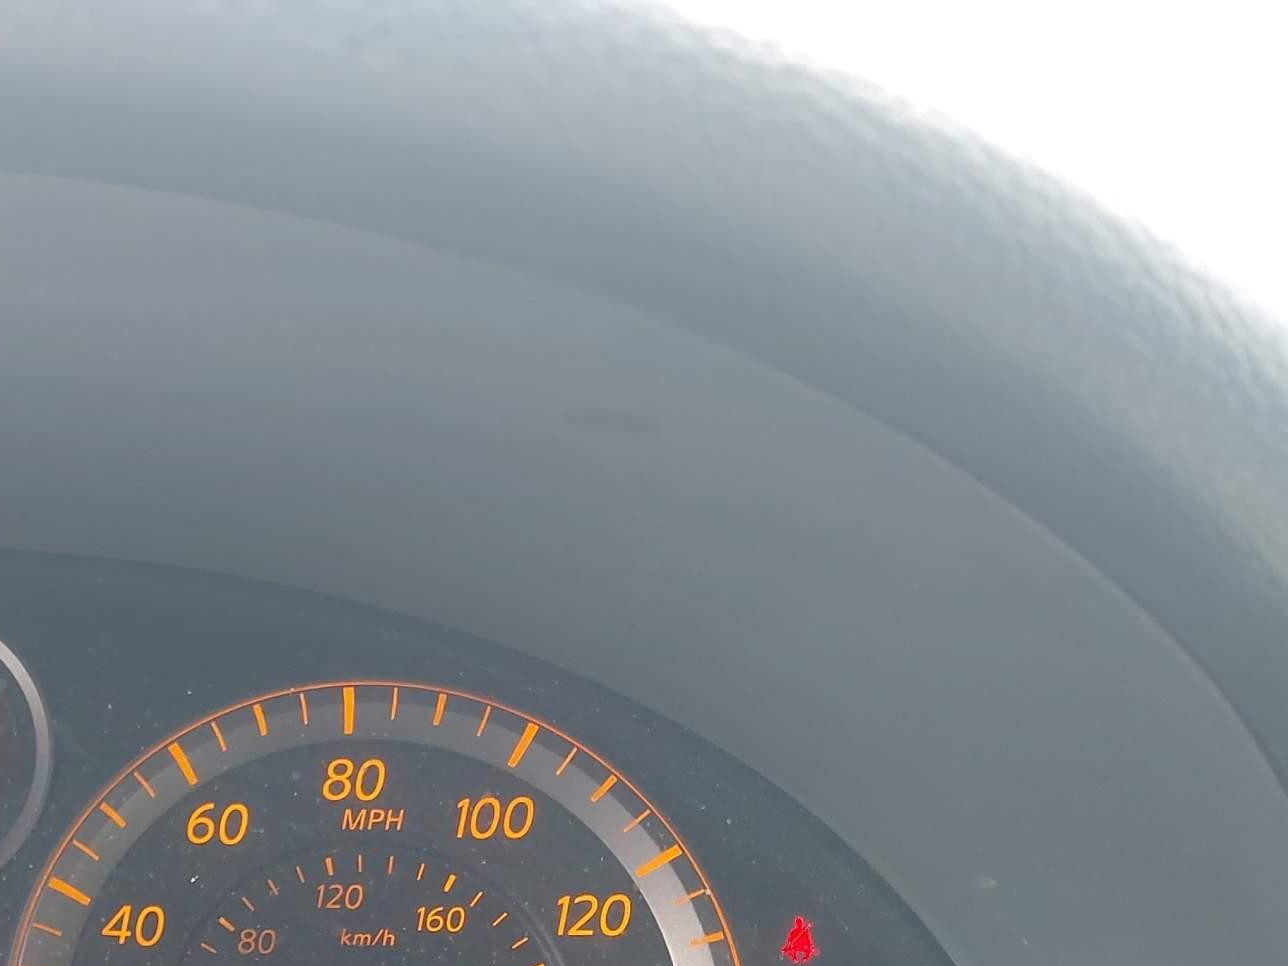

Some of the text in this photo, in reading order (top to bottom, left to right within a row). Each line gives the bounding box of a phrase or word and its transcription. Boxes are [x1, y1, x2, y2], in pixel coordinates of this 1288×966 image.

[321, 758, 386, 801] 80
[186, 802, 249, 846] 60
[341, 808, 405, 832] MPH
[455, 796, 535, 840] 100
[317, 882, 365, 911] 120
[102, 904, 165, 947] 40
[416, 905, 467, 934] 160
[555, 893, 632, 937] 120
[237, 927, 278, 956] 80
[339, 927, 397, 948] km/h
